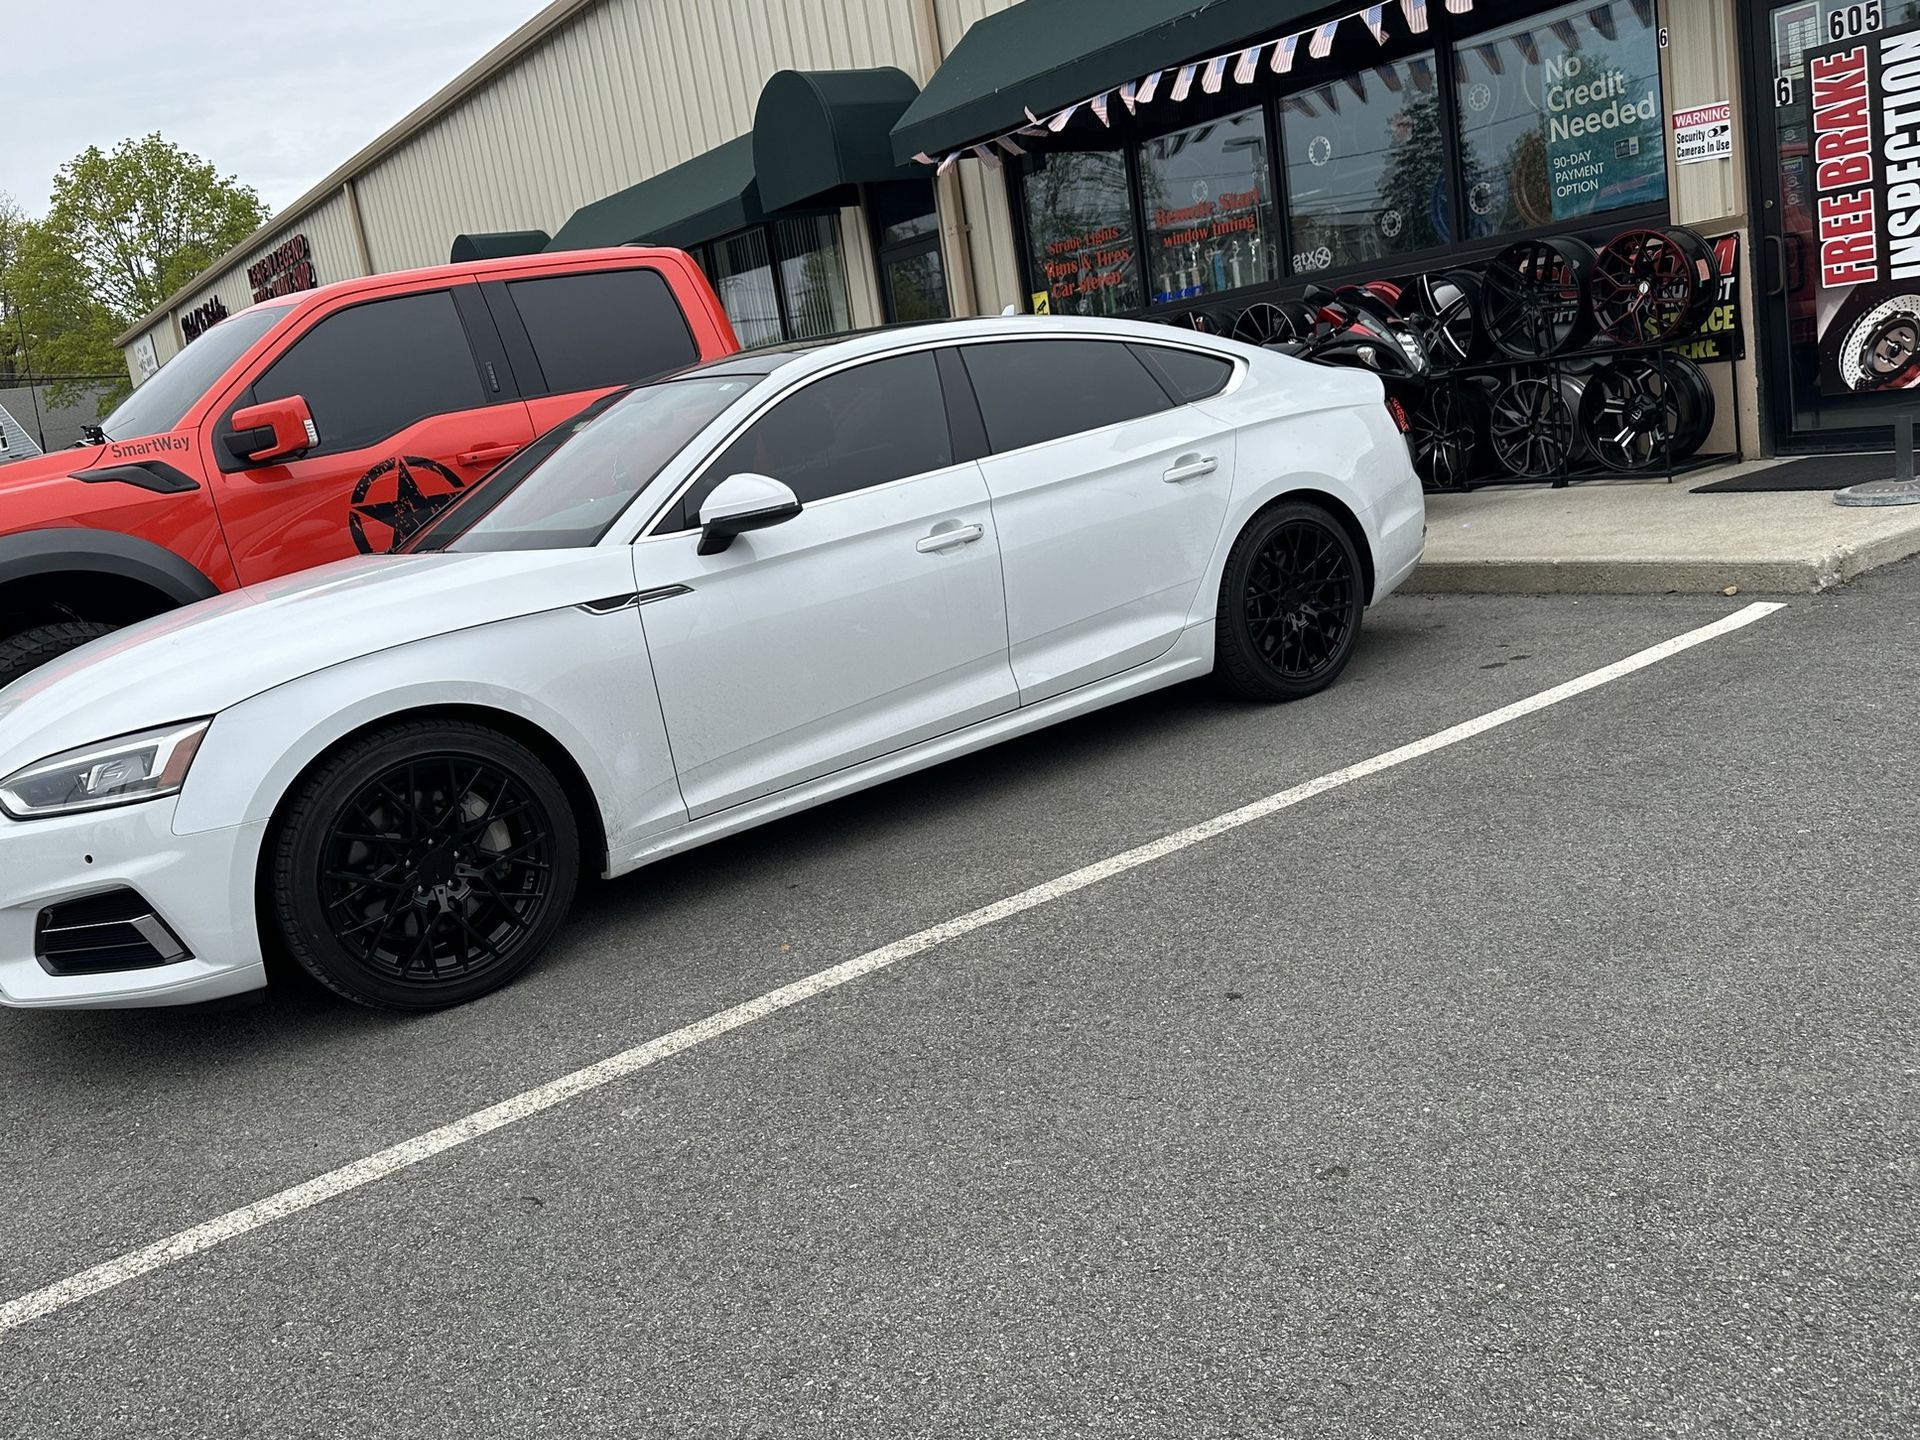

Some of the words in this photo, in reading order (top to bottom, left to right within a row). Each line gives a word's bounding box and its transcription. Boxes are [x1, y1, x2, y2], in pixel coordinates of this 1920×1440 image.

[1830, 1, 1880, 39] 605
[1660, 29, 1667, 46] 6
[1545, 55, 1581, 83] No
[1547, 71, 1625, 112] Credit
[1776, 77, 1790, 105] 6
[1550, 91, 1656, 143] Needed
[1675, 106, 1730, 127] WARNING
[1811, 45, 1873, 191] BRAKE
[1677, 130, 1706, 144] Security
[1677, 145, 1706, 158] Cameras
[1707, 141, 1714, 152] In
[1716, 140, 1730, 151] Use
[1553, 150, 1592, 169] 90-DAY
[1880, 30, 1920, 280] INSPECTION
[1555, 162, 1604, 183] PAYMENT
[1556, 178, 1599, 198] OPTION
[1163, 226, 1208, 248] window
[1212, 213, 1257, 236] tinting
[1818, 188, 1878, 288] FREE
[1045, 260, 1079, 279] Rims
[1095, 247, 1131, 267] Tires
[111, 436, 190, 458] SmartWay
